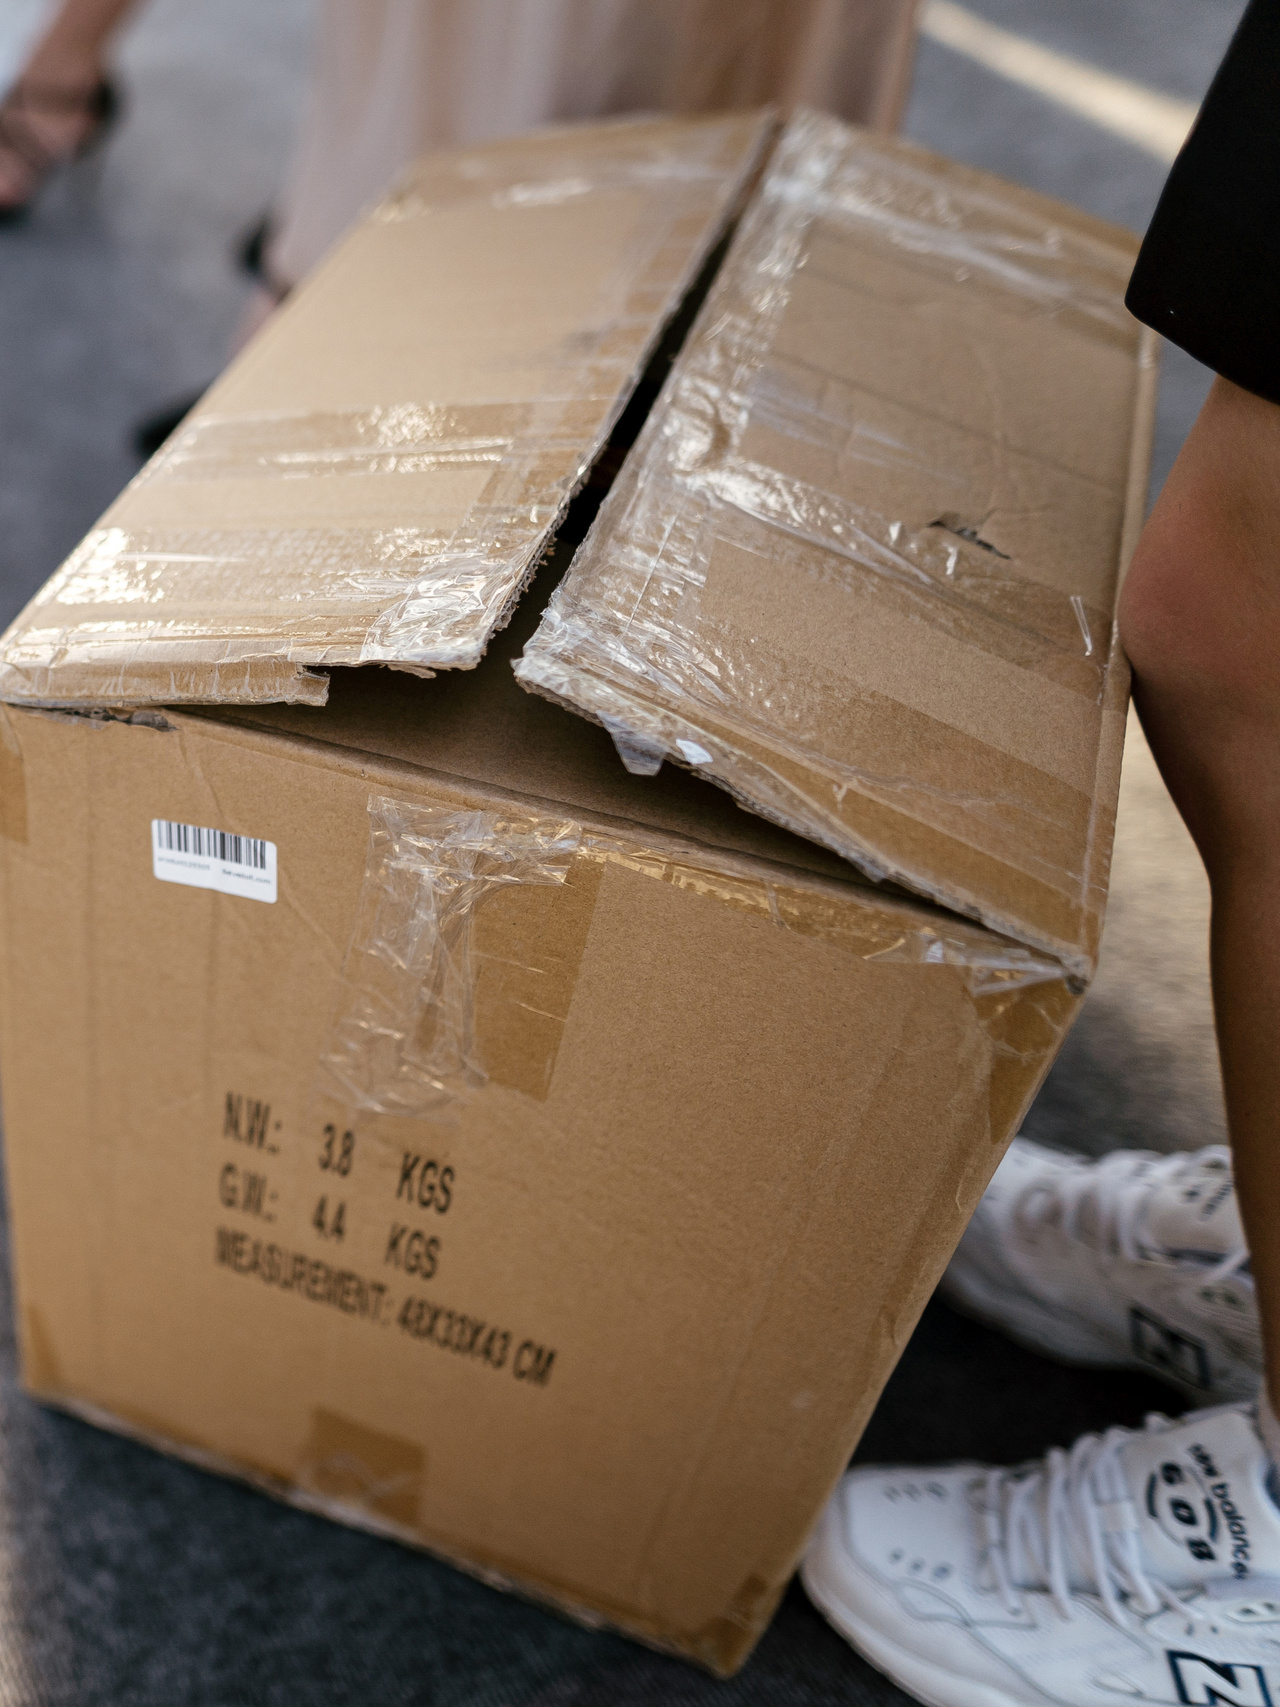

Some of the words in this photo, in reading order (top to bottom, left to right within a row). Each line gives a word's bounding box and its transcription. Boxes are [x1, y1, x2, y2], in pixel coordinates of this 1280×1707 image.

[318, 1122, 356, 1178] 3.8
[396, 1151, 455, 1215] KGS
[383, 1221, 441, 1280] KGS
[215, 1225, 394, 1326] MEASUREMENT:
[512, 1338, 558, 1387] CM
[1165, 1649, 1273, 1707] N
